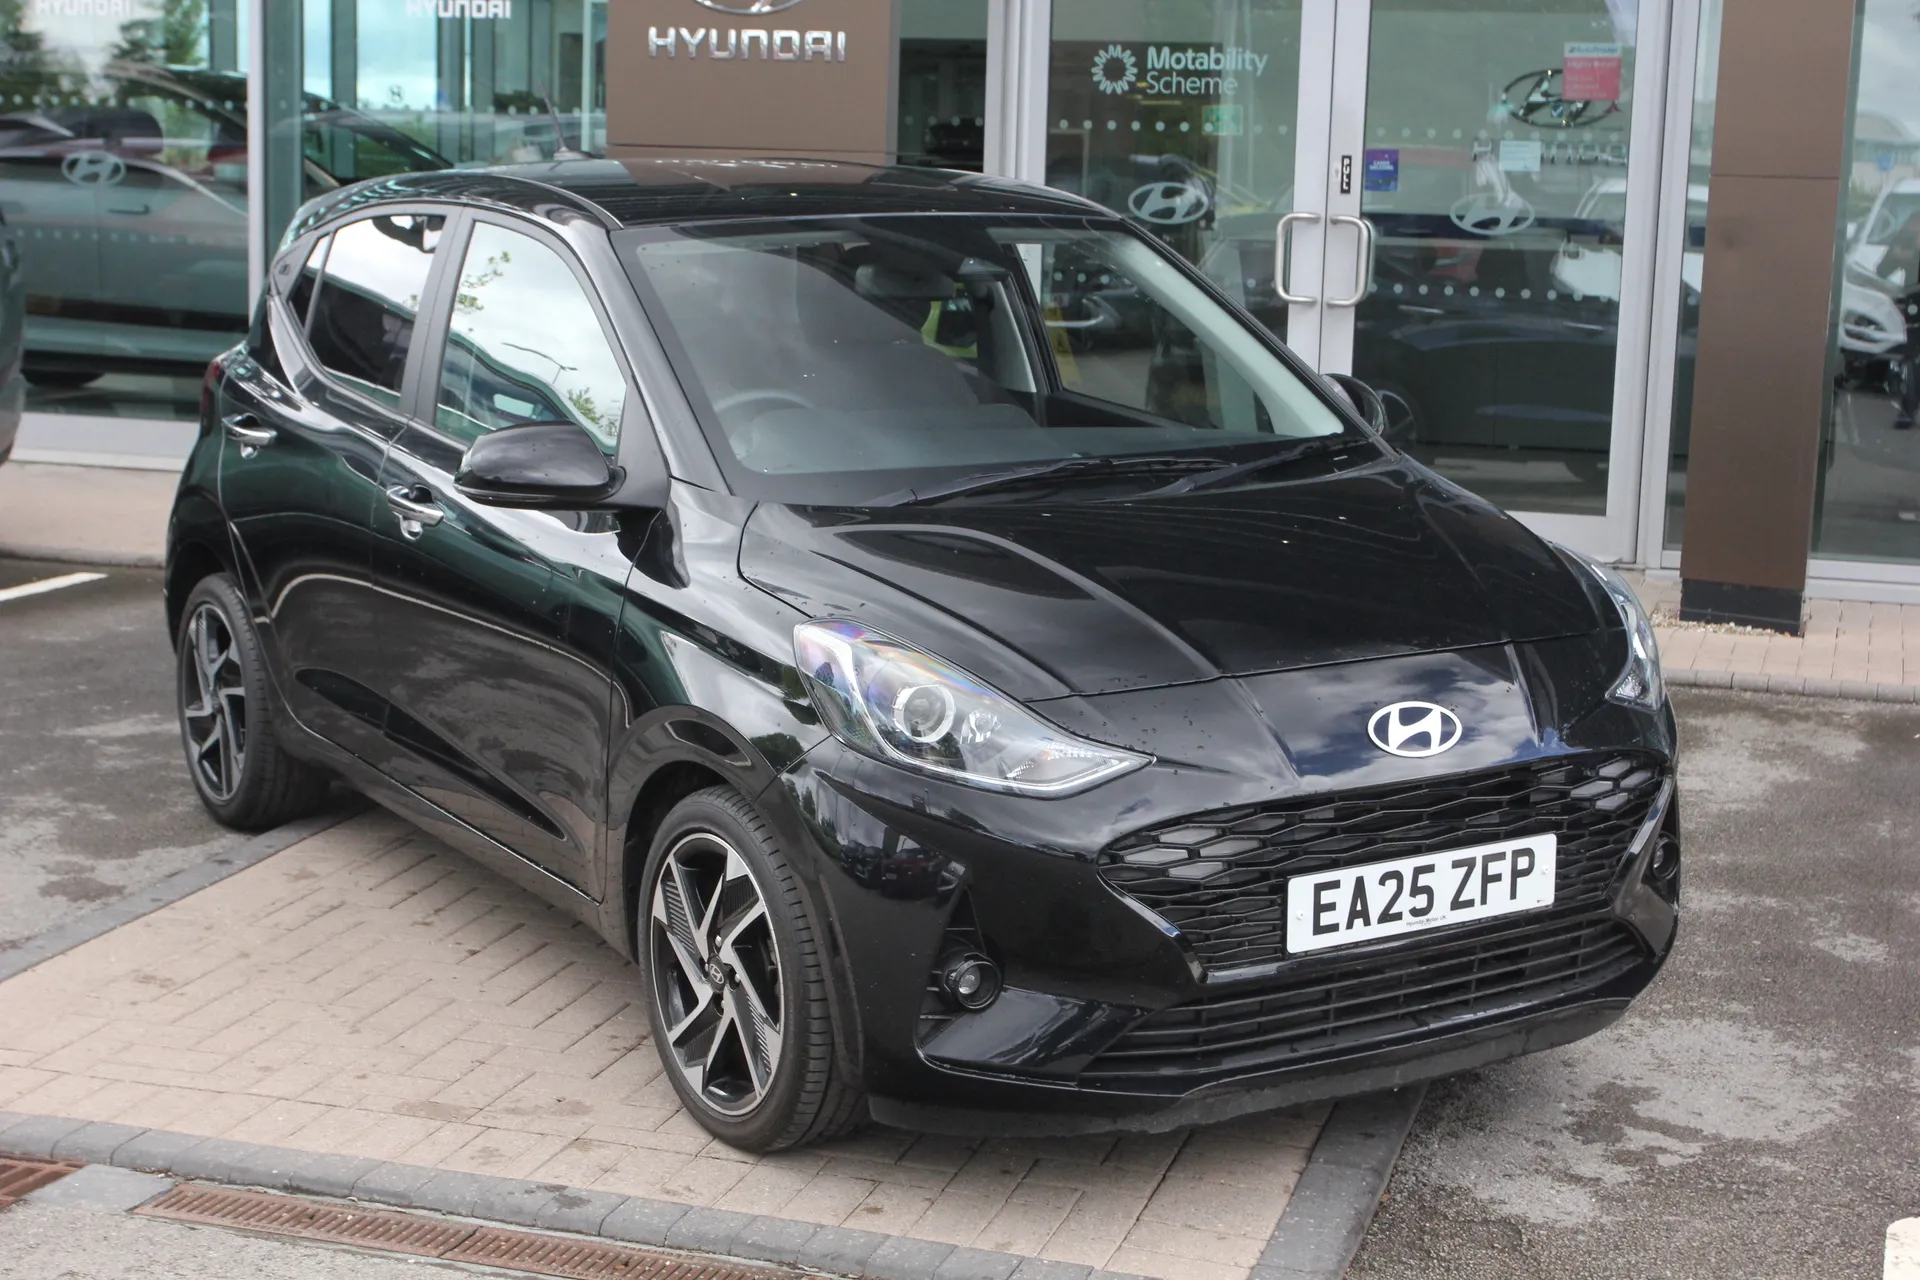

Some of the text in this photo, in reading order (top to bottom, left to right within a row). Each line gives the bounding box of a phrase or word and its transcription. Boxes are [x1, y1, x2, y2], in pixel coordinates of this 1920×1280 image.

[35, 0, 131, 16] HYUNDAI
[406, 0, 511, 18] HYUNDAI
[648, 26, 846, 62] HYUNDAI
[1147, 46, 1268, 77] Motability
[1146, 71, 1238, 95] Scheme
[1342, 157, 1351, 190] PULL
[1312, 847, 1536, 936] EA25 ZFP
